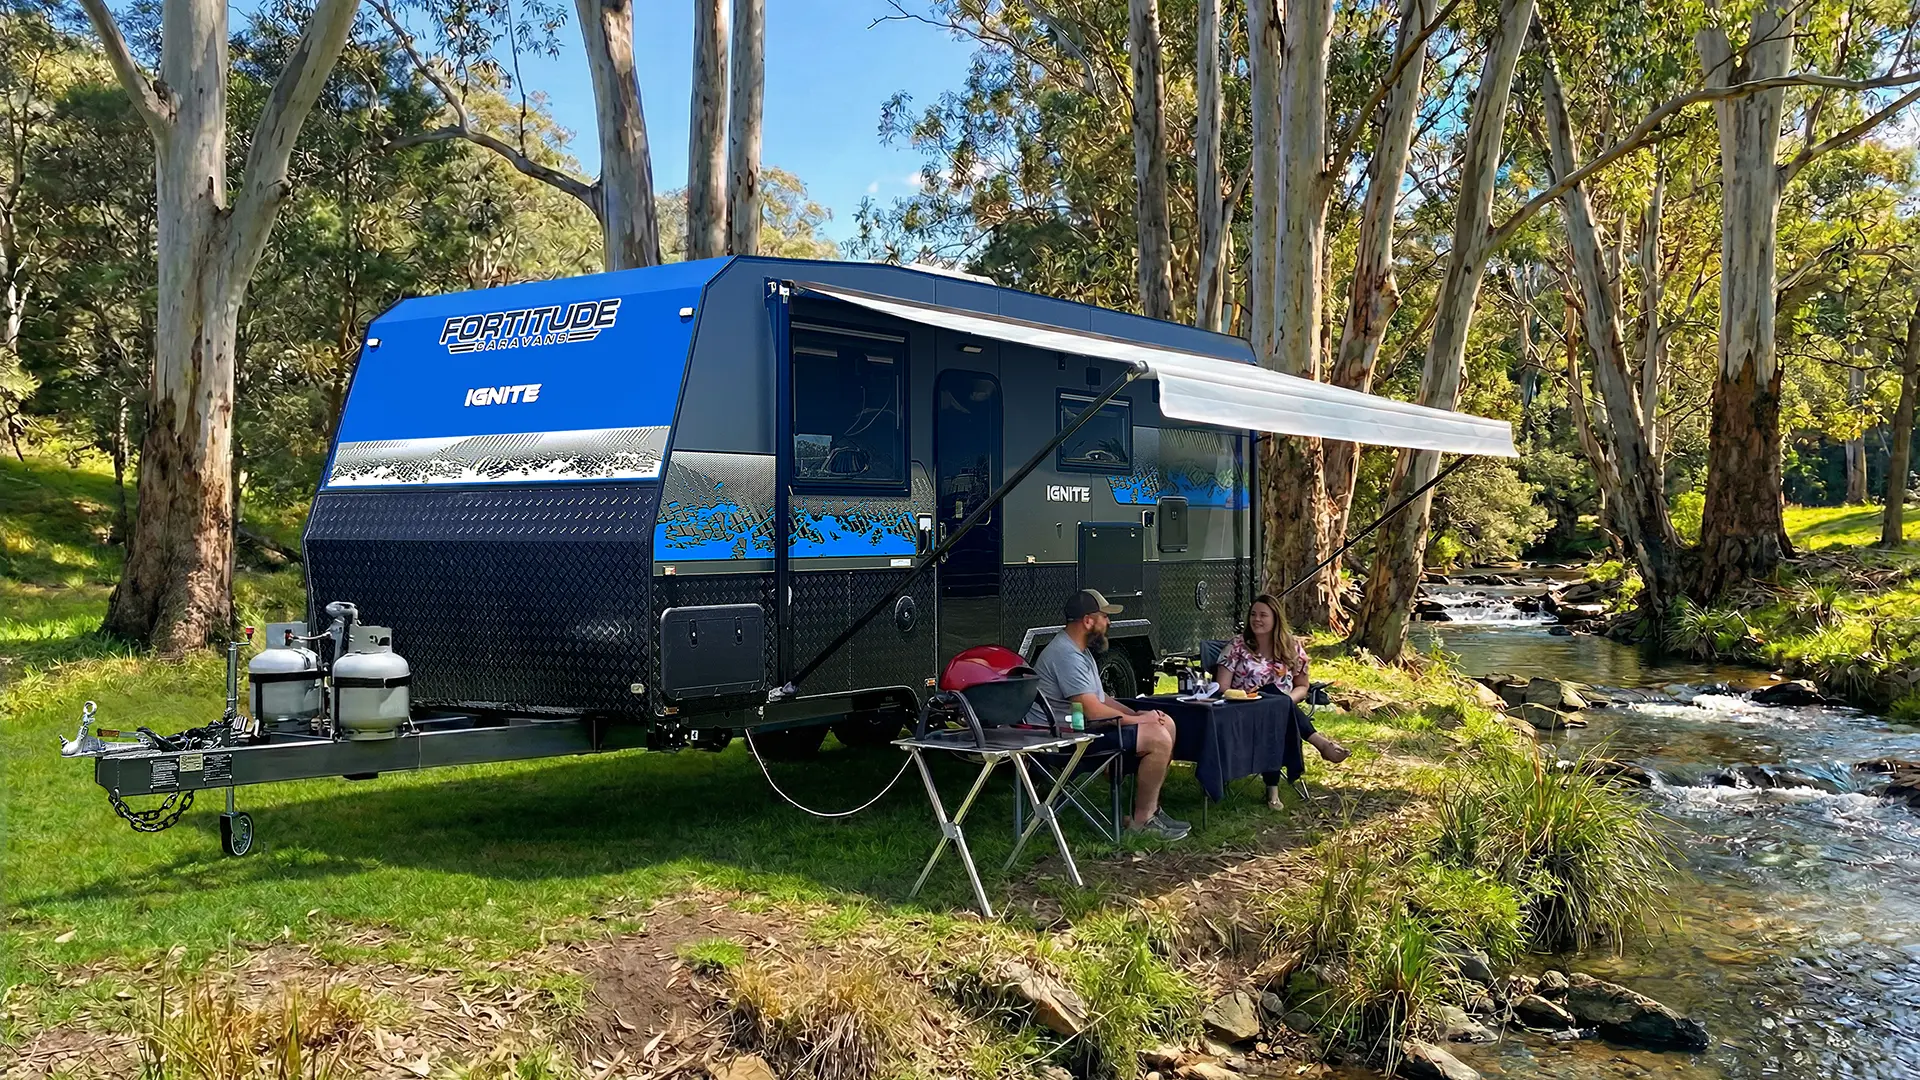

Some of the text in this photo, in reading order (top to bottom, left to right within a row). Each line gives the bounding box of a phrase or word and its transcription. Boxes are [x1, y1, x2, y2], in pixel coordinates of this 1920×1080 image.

[439, 298, 621, 345] FORTITUDE
[476, 332, 567, 352] CARAVANS
[464, 383, 542, 407] IGNITE
[1046, 484, 1090, 503] IGNITE
